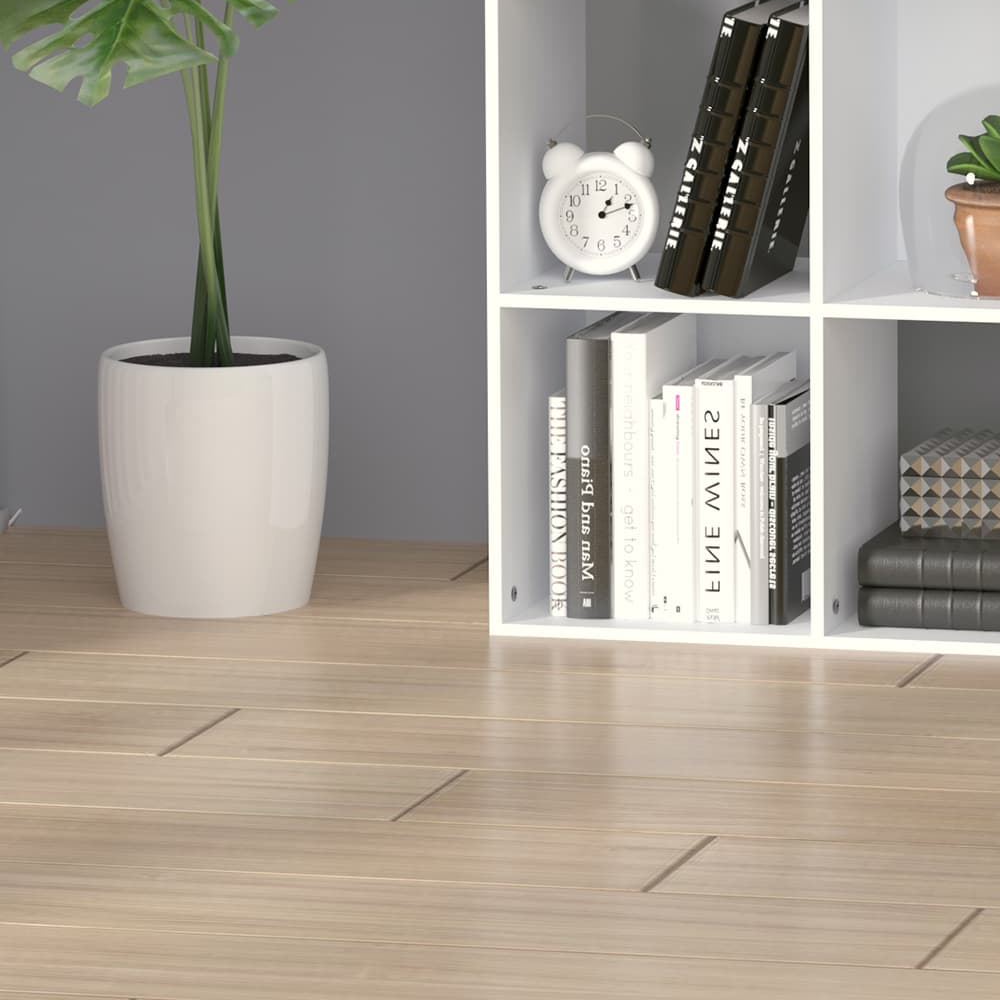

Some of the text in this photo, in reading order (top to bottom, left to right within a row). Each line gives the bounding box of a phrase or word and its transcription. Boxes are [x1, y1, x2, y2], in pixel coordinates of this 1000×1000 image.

[581, 183, 589, 196] 11
[595, 179, 607, 192] 12
[614, 183, 619, 195] 1
[569, 194, 581, 207] 10
[565, 210, 574, 222] 9
[569, 224, 579, 237] 8
[622, 224, 631, 236] 4
[582, 236, 589, 248] 7
[597, 239, 605, 252] 6
[613, 235, 621, 248] 5
[624, 560, 637, 604] know
